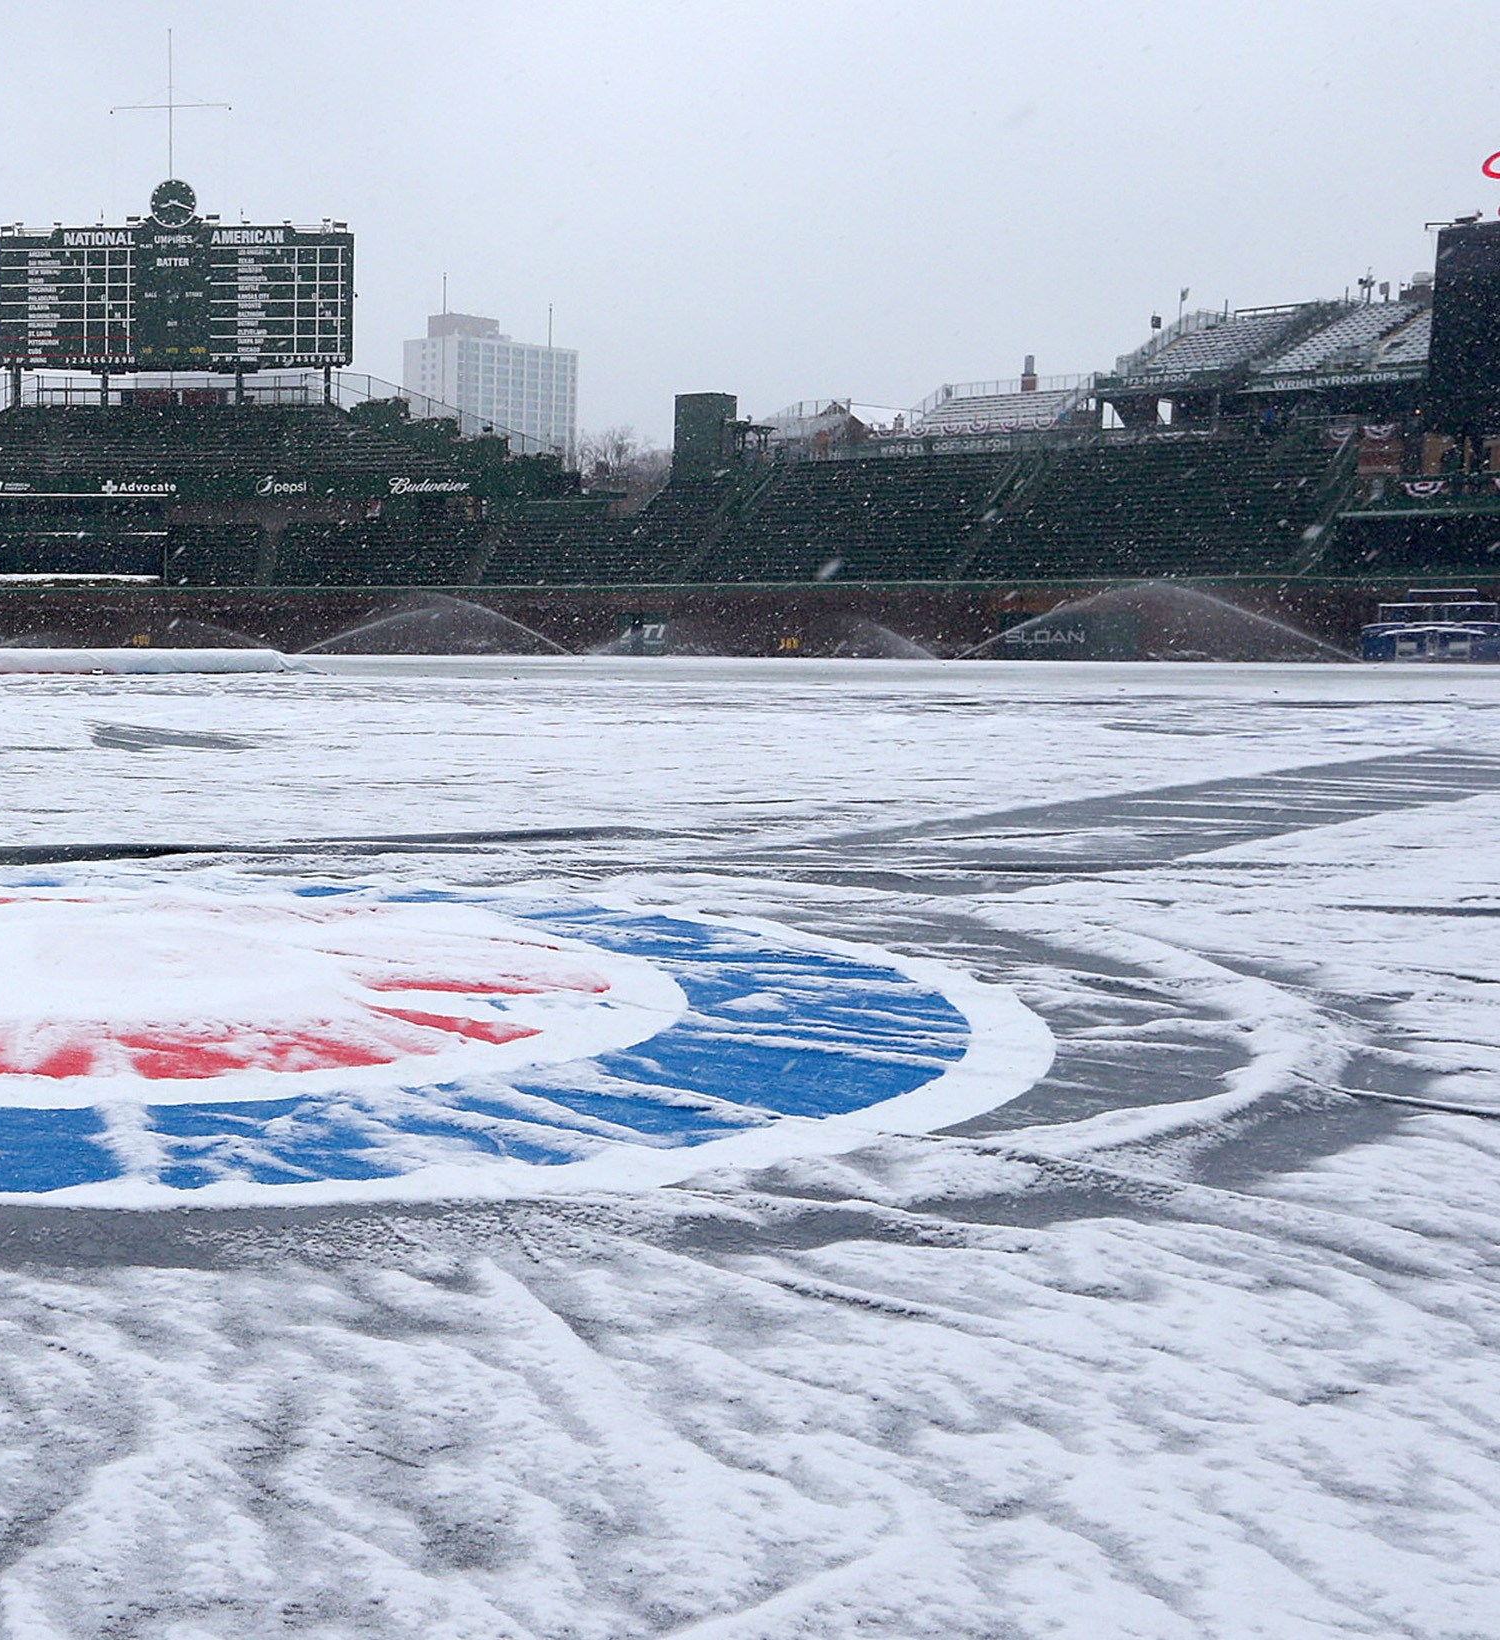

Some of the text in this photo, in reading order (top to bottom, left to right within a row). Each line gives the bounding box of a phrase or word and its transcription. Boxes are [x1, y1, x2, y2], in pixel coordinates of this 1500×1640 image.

[63, 231, 136, 245] NATIONAL
[154, 235, 193, 244] UMPIRES
[211, 230, 284, 244] AMERICAN
[156, 257, 189, 267] BATTER
[119, 482, 177, 492] Advocate
[273, 480, 307, 494] pepsi
[388, 477, 471, 494] Budweiser
[1004, 630, 1085, 644] SLOAN
